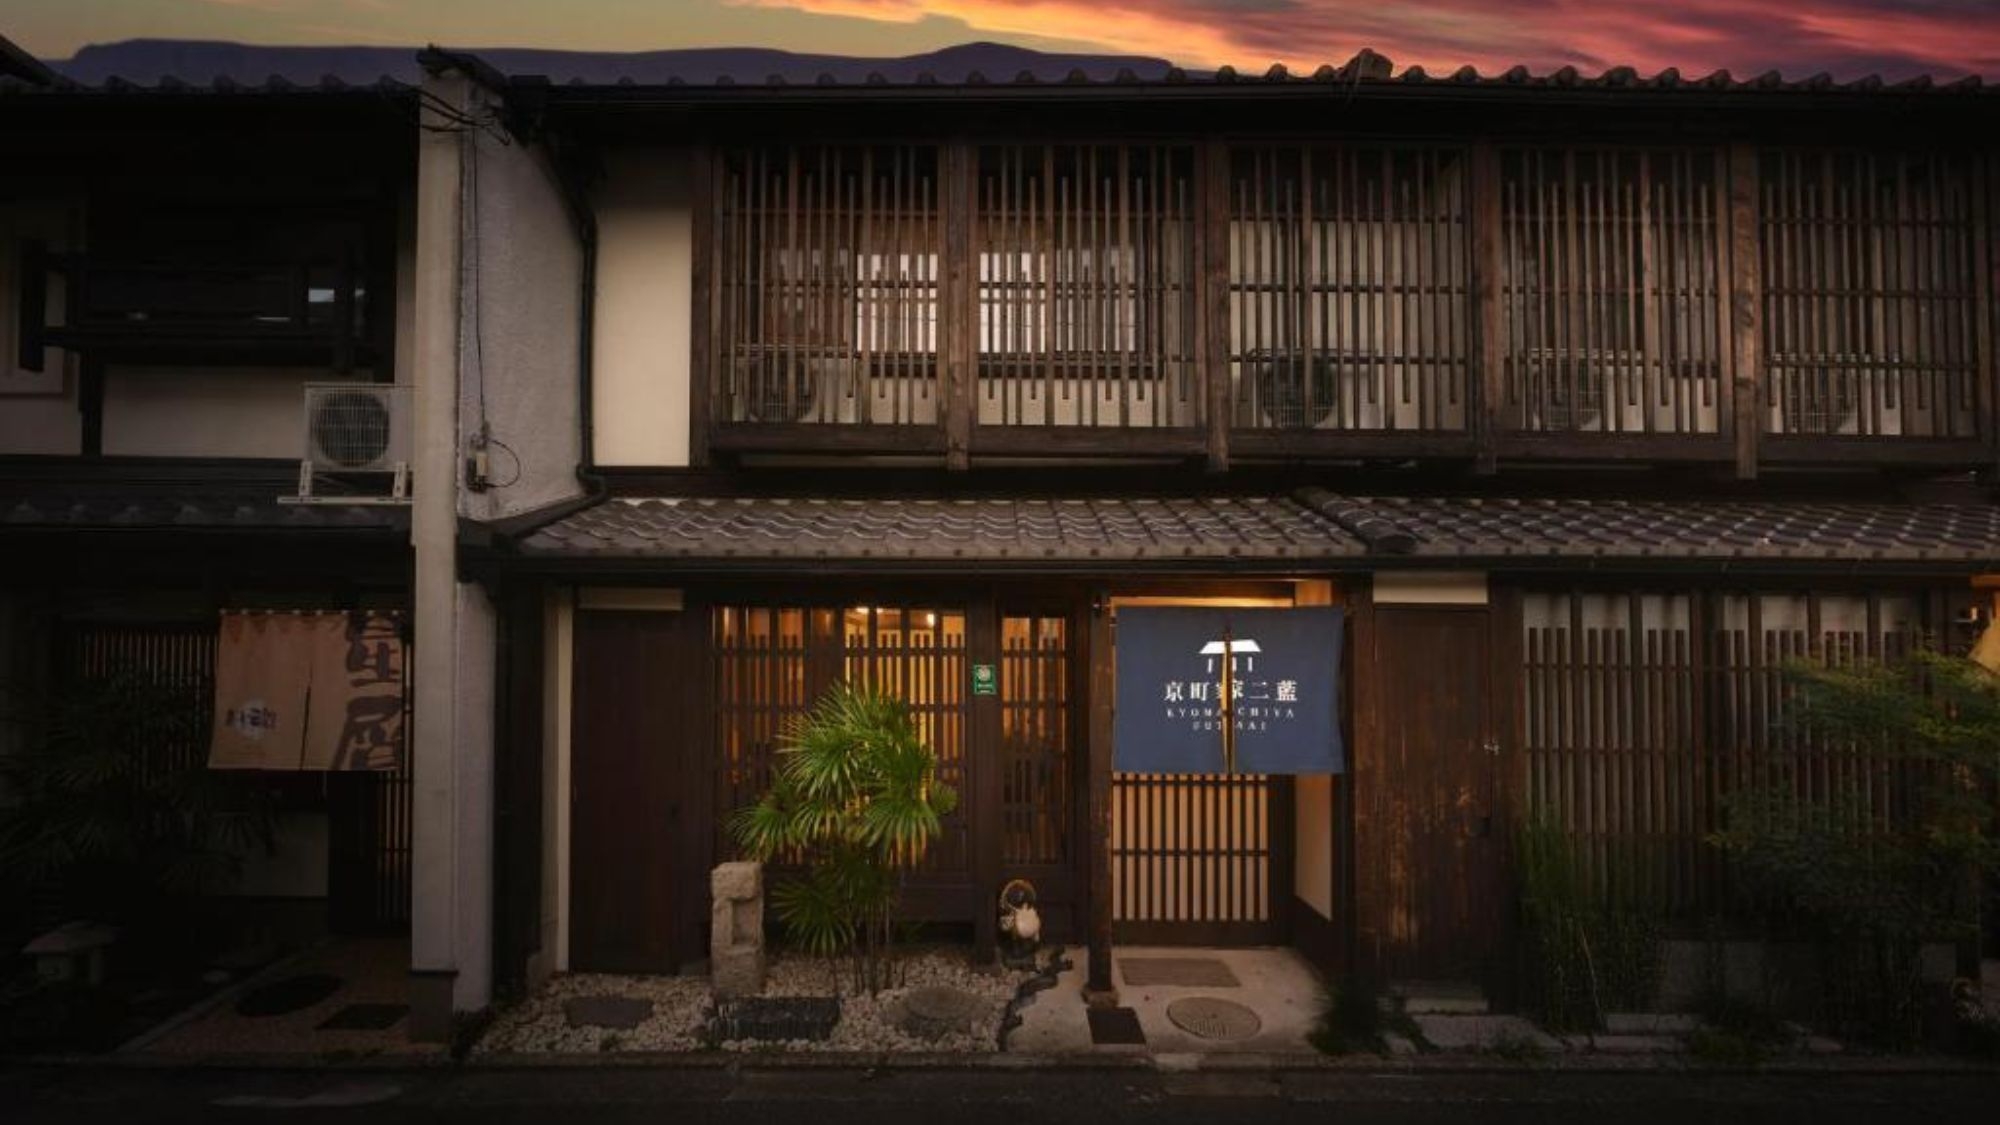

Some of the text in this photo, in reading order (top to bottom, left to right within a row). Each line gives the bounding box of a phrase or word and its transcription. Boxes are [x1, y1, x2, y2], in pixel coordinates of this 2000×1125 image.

[1164, 679, 1298, 702] 京町家二藍
